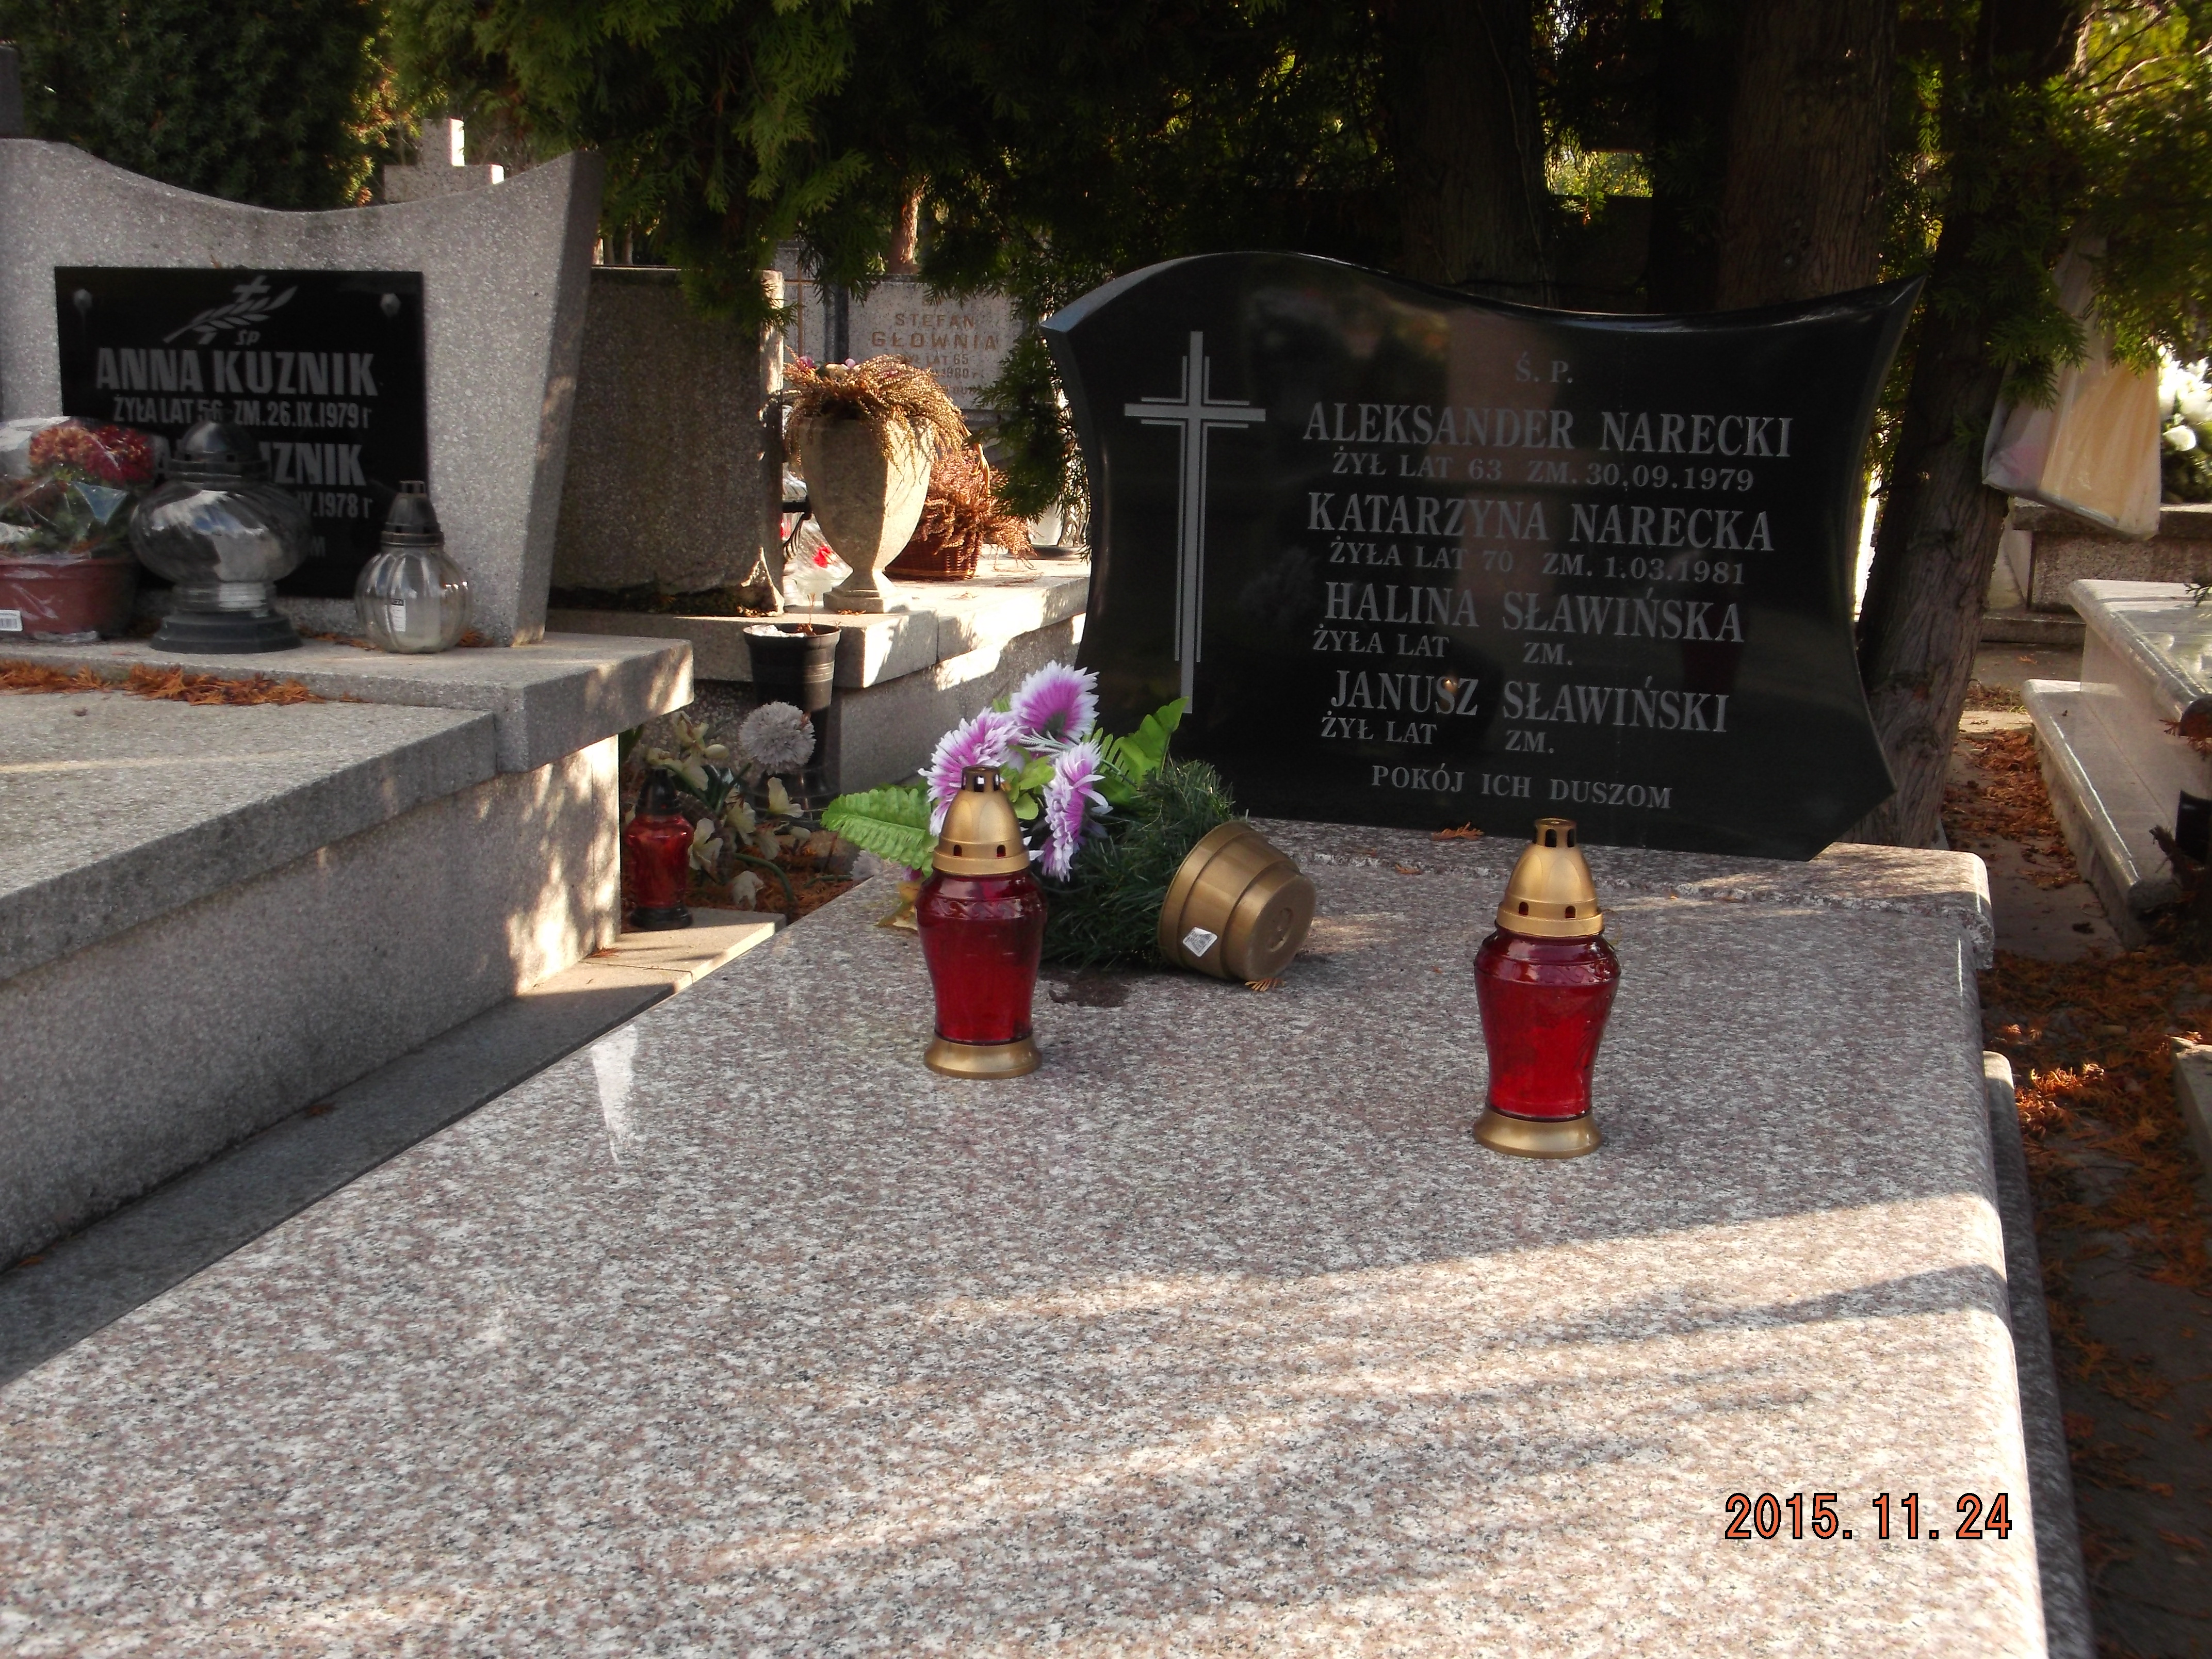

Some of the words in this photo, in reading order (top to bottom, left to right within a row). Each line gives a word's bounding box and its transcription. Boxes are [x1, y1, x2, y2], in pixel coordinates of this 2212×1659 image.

[872, 332, 997, 350] GŁOWNIA
[895, 314, 975, 328] STEFAN
[95, 347, 204, 393] ANNA
[213, 350, 378, 397] KUZNIK
[113, 394, 157, 424] ŻYŁA
[161, 397, 194, 424] LAT
[1303, 402, 1574, 449] ALEKSANDER
[1599, 411, 1794, 458] NARECKI
[258, 442, 367, 486] ZNIK
[1332, 446, 1387, 476] ŻYŁ
[1400, 454, 1453, 479] LAT
[1469, 459, 1502, 480] 63
[1528, 460, 1576, 484] ZM.
[1586, 463, 1754, 492] 30.09.1979
[1307, 492, 1550, 541] KATARZYNA
[1570, 503, 1775, 551] NARECKA
[1329, 535, 1402, 565] ŻYŁA
[1415, 546, 1468, 570] LAT
[1483, 550, 1514, 572] 70
[1543, 553, 1592, 576] ZM.
[1604, 556, 1745, 585] 1.03.1981
[1325, 582, 1479, 628] HALINA
[1502, 587, 1744, 643] SŁAWIŃSKA
[1313, 624, 1384, 654] ŻYŁA
[1397, 634, 1449, 658] LAT
[1523, 642, 1573, 665] ZM.
[1331, 670, 1479, 716] JANUSZ
[1503, 675, 1730, 733] SŁAWIŃSKI
[1321, 709, 1374, 739] ŻYŁ
[1386, 721, 1437, 745] LAT
[1505, 729, 1554, 753] ZM.
[1372, 761, 1465, 793] POKÓJ
[1482, 773, 1531, 799] ICH
[1551, 778, 1673, 809] DUSZOM
